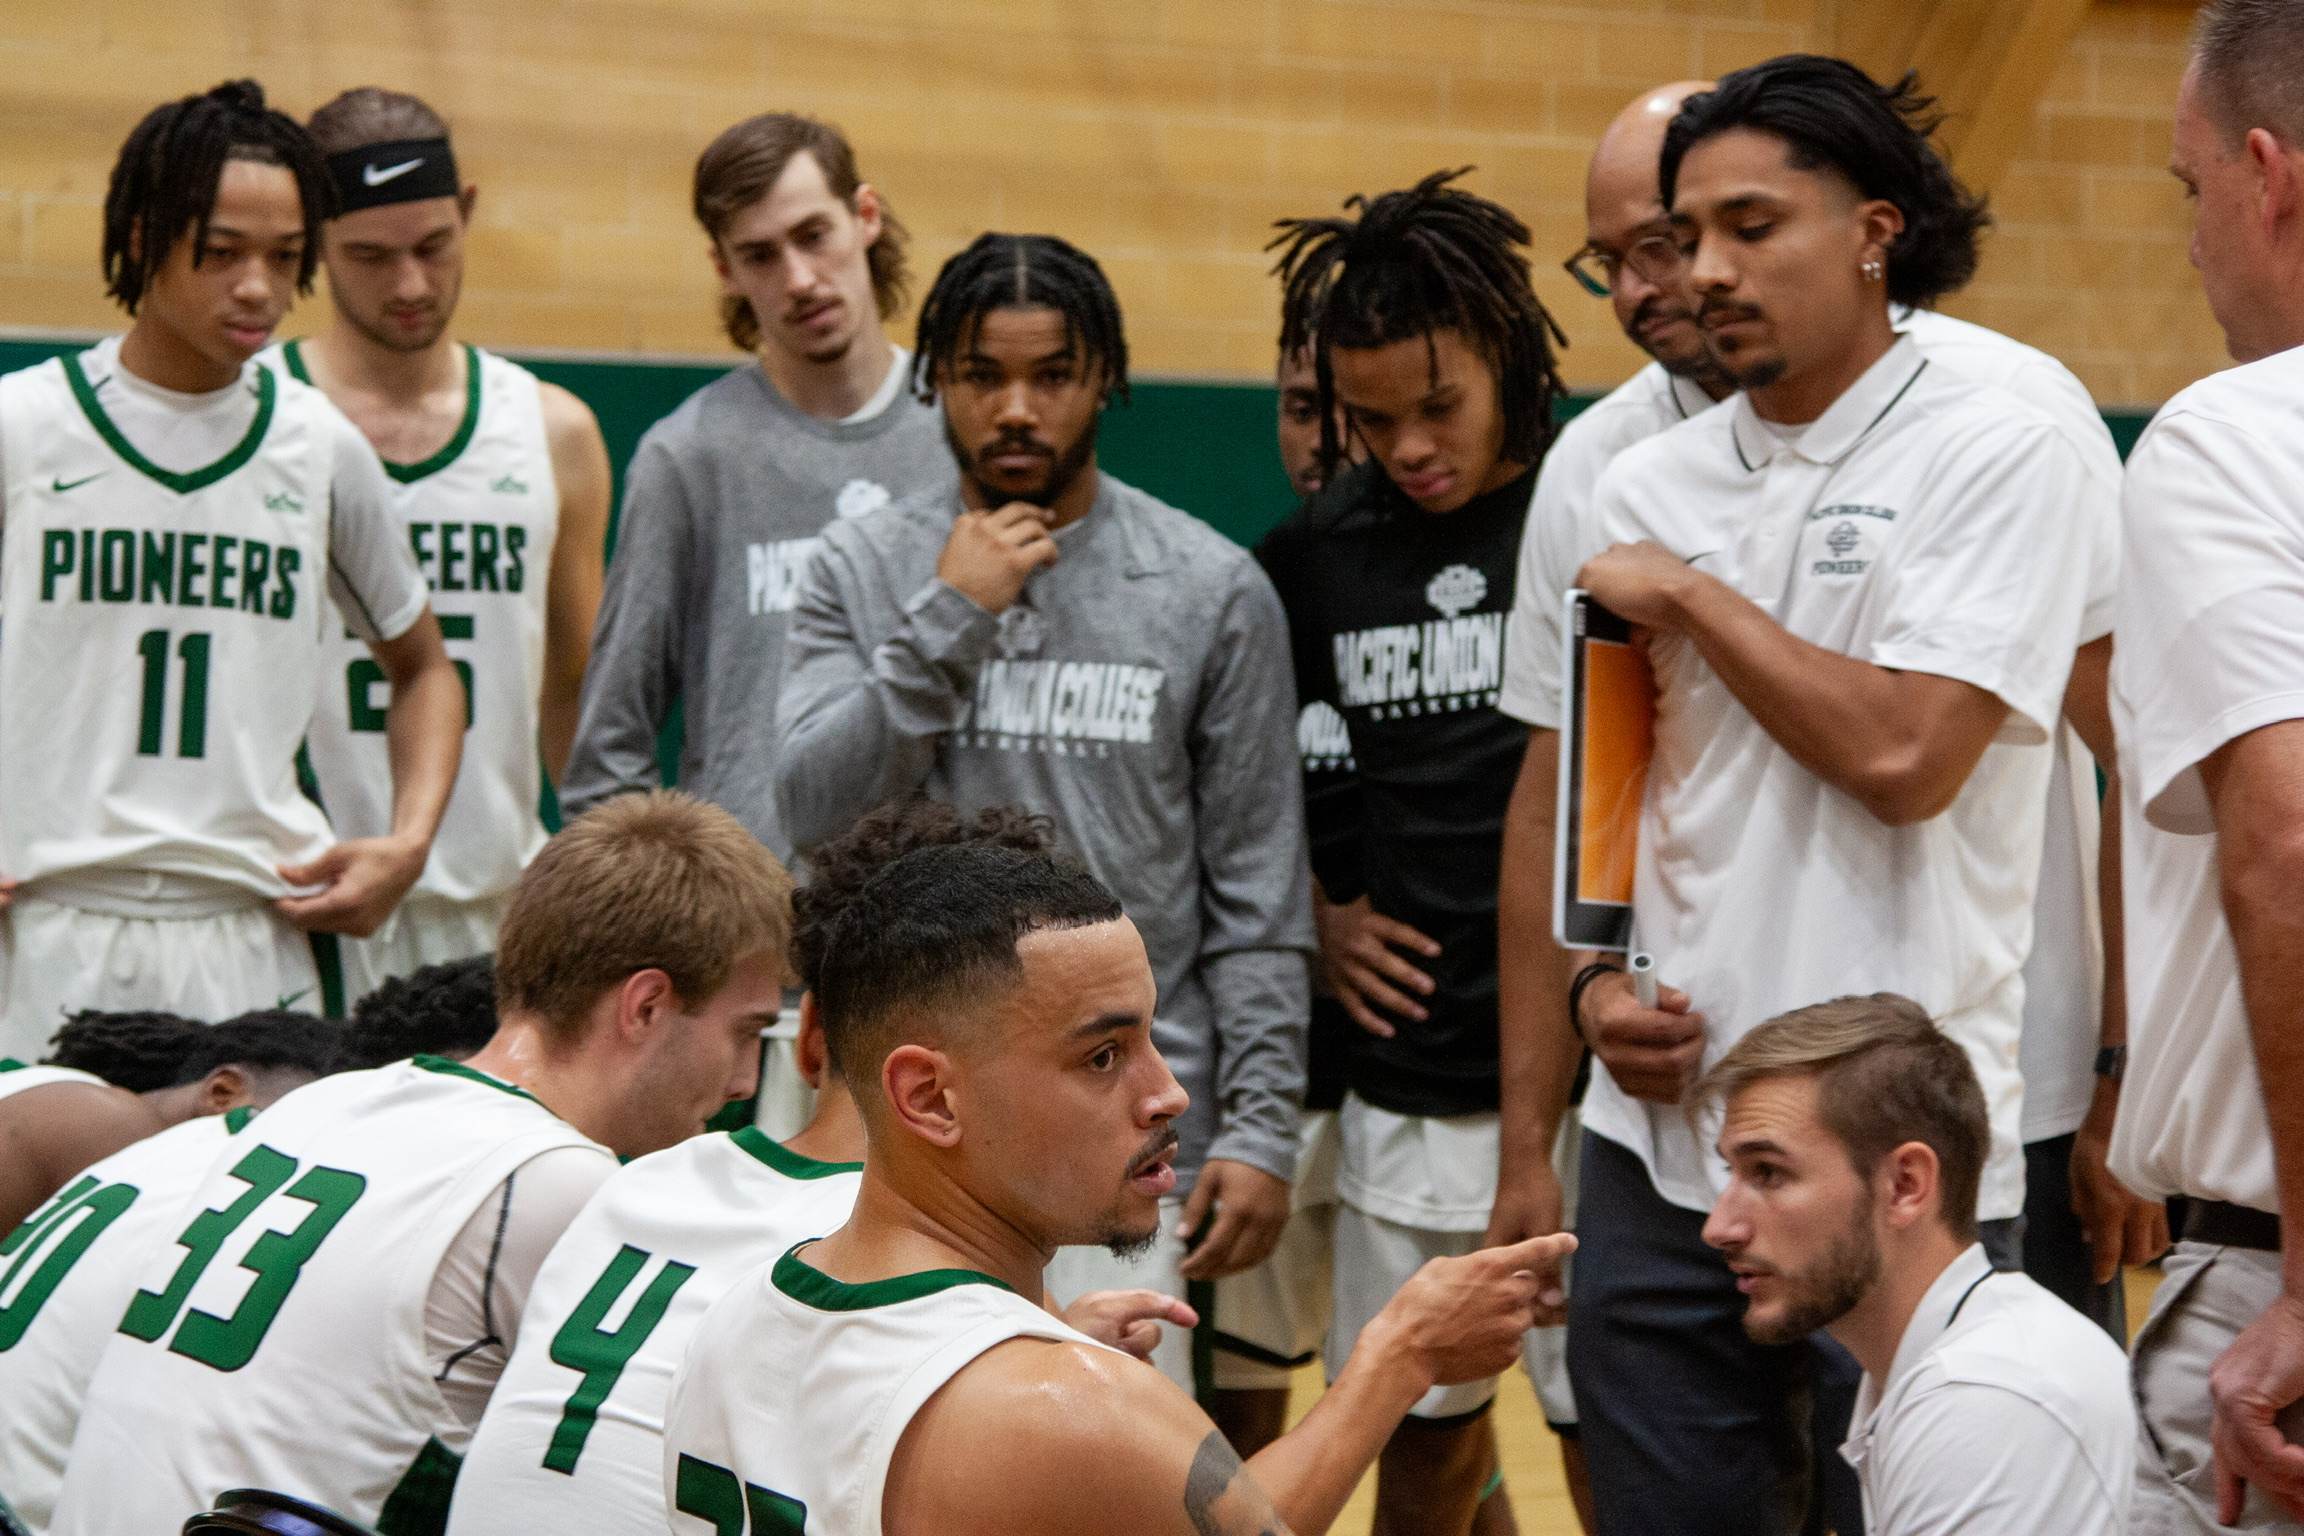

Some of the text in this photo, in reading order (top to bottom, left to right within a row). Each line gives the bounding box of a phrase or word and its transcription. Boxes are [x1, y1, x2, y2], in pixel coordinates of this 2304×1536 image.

[41, 528, 302, 621] PIONEERS
[136, 628, 212, 759] 11
[0, 1174, 141, 1353] 0
[118, 1143, 367, 1373] 33
[541, 1244, 699, 1476] 4
